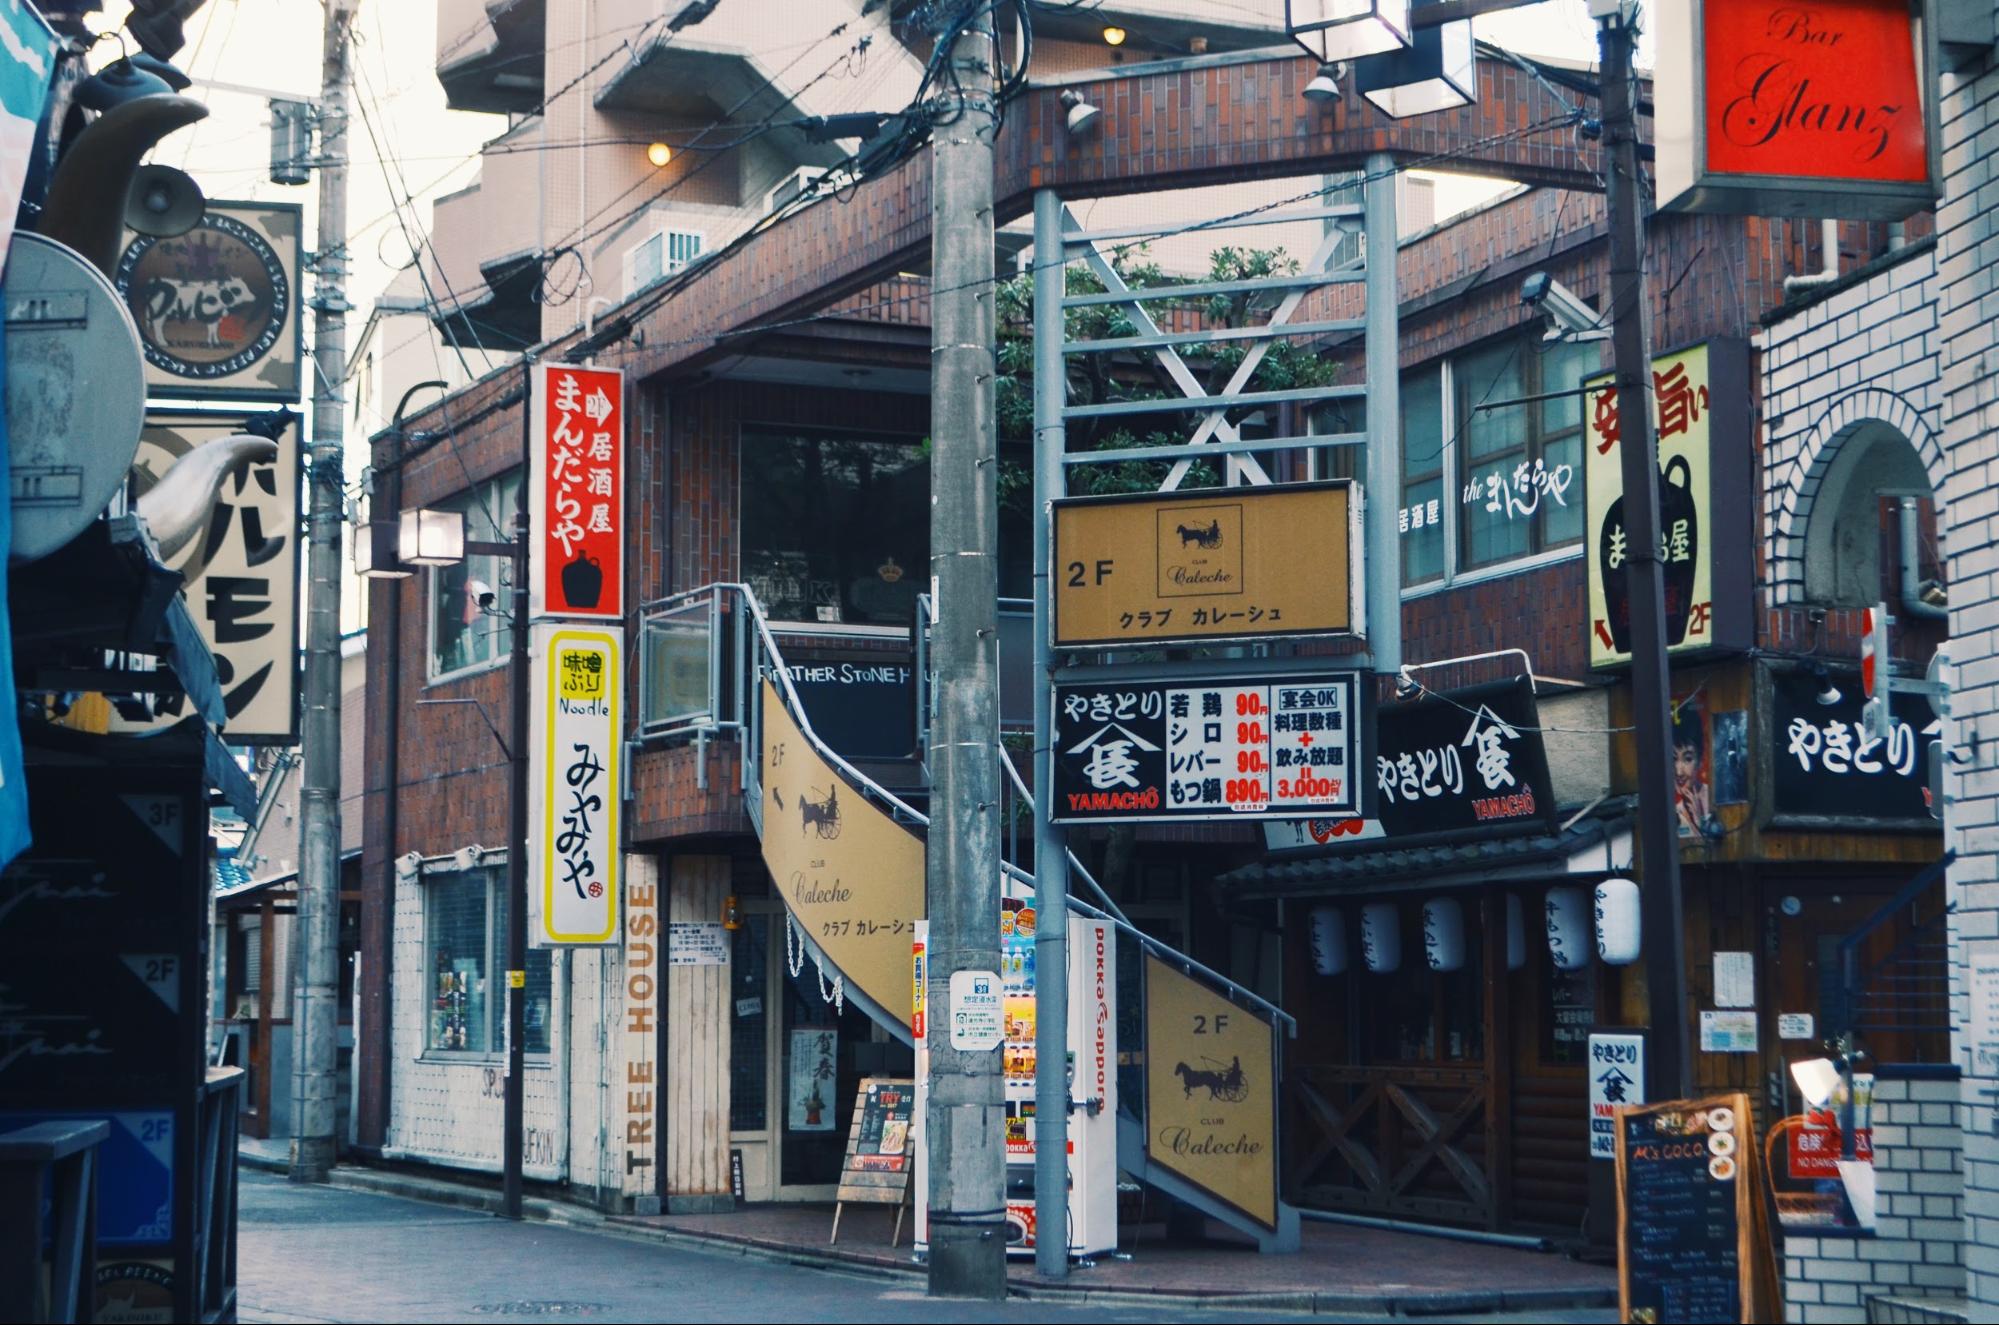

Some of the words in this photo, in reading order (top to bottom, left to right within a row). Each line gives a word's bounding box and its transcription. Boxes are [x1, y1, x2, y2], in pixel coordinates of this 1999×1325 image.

[1767, 7, 1846, 46] Bar
[1722, 52, 1901, 163] Glanz
[1653, 362, 1710, 439] 旨い
[552, 374, 584, 557] まんだらや
[587, 432, 613, 533] 居酒屋
[1463, 476, 1483, 504] the
[1485, 458, 1572, 520] まんだらや
[1399, 499, 1439, 533] 居酒屋
[1068, 560, 1113, 587] 2F
[1167, 565, 1233, 586] Caleche
[1120, 608, 1172, 629] クラブ
[1193, 606, 1281, 626] カレーシュ
[1689, 602, 1711, 635] 2F
[840, 664, 896, 684] STONE
[560, 697, 609, 716] Noodle
[1064, 689, 1162, 722] やきとり
[1170, 692, 1222, 719] 若鶏
[1235, 692, 1269, 716] 90円
[1282, 688, 1336, 709] 宴会OK
[1170, 722, 1222, 745] シロ
[1236, 721, 1269, 745] 90円
[1274, 712, 1343, 733] 料理数種
[771, 744, 785, 767] 2F
[1276, 747, 1344, 769] 飲み放題
[1788, 717, 1915, 776] やきとり
[1170, 751, 1221, 774] レバー
[1236, 750, 1269, 774] 90円
[1377, 744, 1463, 804] やきとり
[1170, 778, 1222, 805] もつ鍋
[1225, 779, 1269, 803] 890円
[149, 803, 178, 827] 3F
[790, 871, 853, 908] Caleche
[823, 920, 850, 937] クラブ
[146, 958, 175, 982] 2F
[626, 884, 655, 1034] HOUSE
[1193, 1014, 1228, 1034] 2F
[1592, 1043, 1637, 1064] やきとり
[141, 1119, 170, 1142] 2F
[626, 1060, 654, 1176] TREE
[1200, 1118, 1225, 1126] CLUB
[1159, 1125, 1264, 1159] Caleche
[1663, 1142, 1703, 1160] COCO
